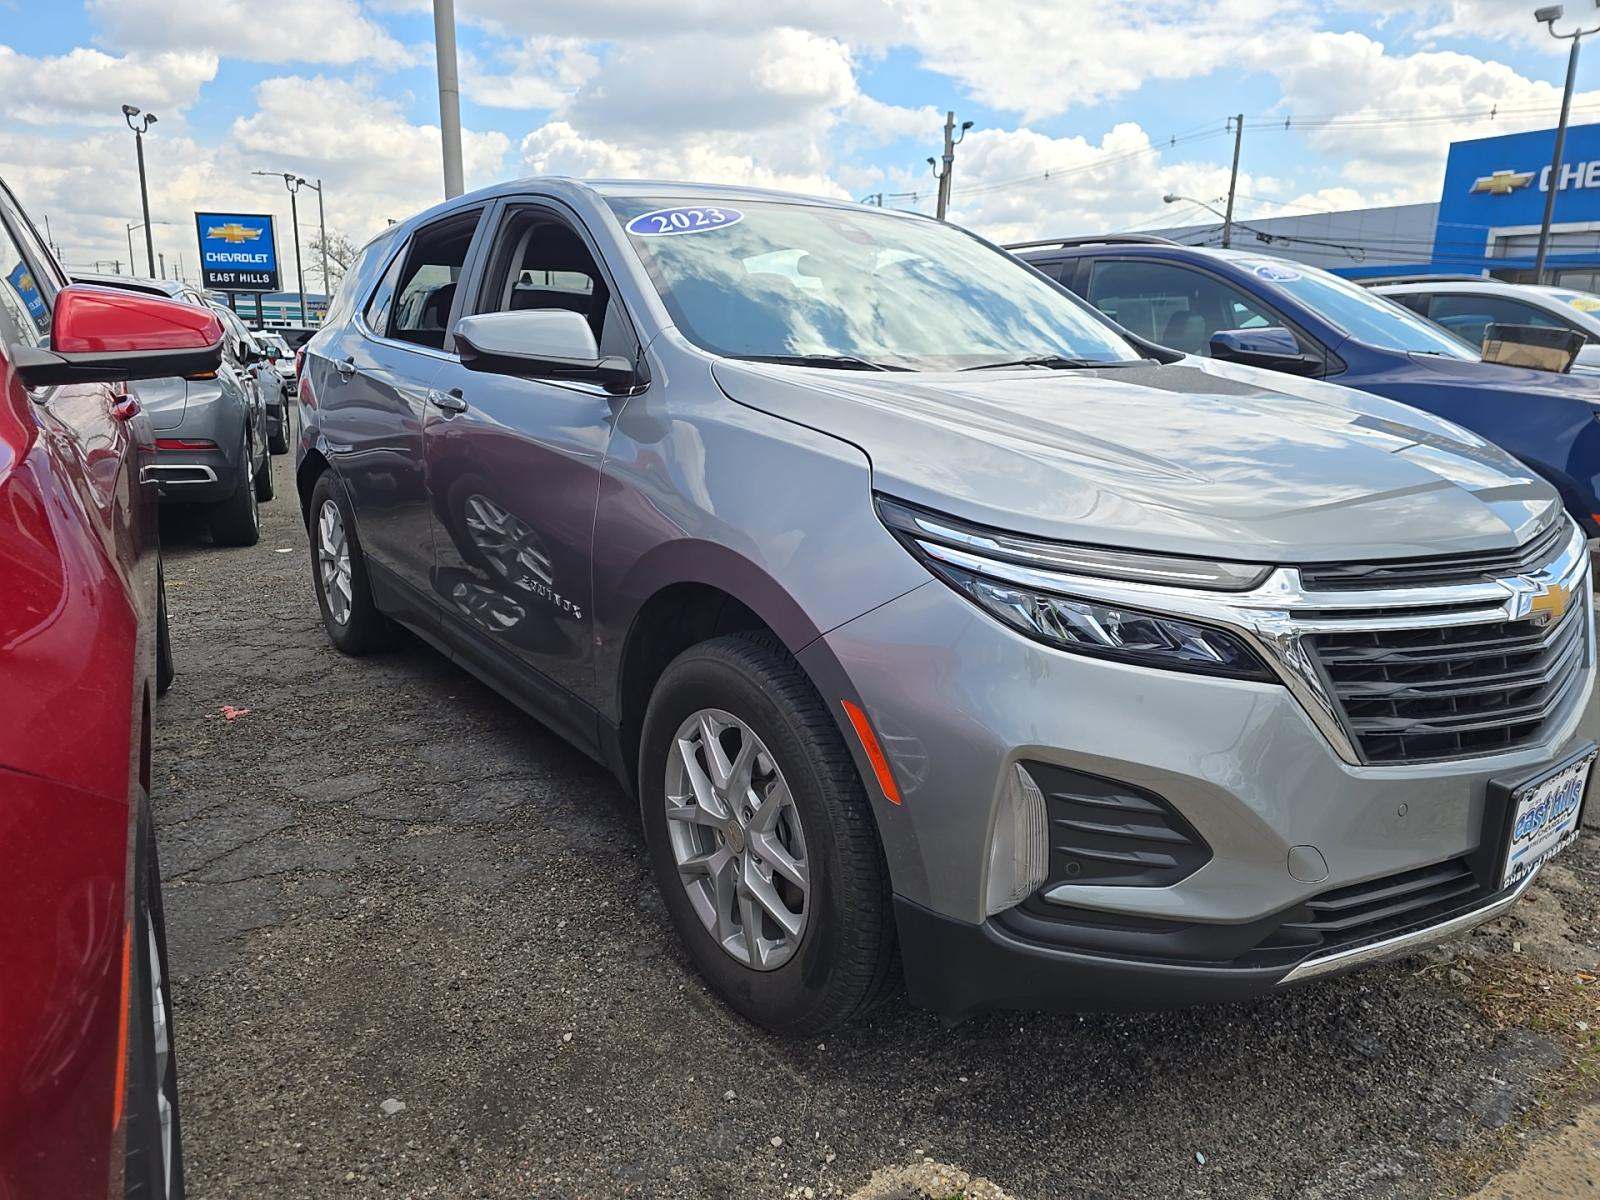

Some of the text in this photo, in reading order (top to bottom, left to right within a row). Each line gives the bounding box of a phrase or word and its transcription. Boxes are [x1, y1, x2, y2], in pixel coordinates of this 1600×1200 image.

[651, 208, 726, 233] 2023
[206, 252, 268, 263] CHEVROLET
[210, 273, 270, 283] EAST HILLS
